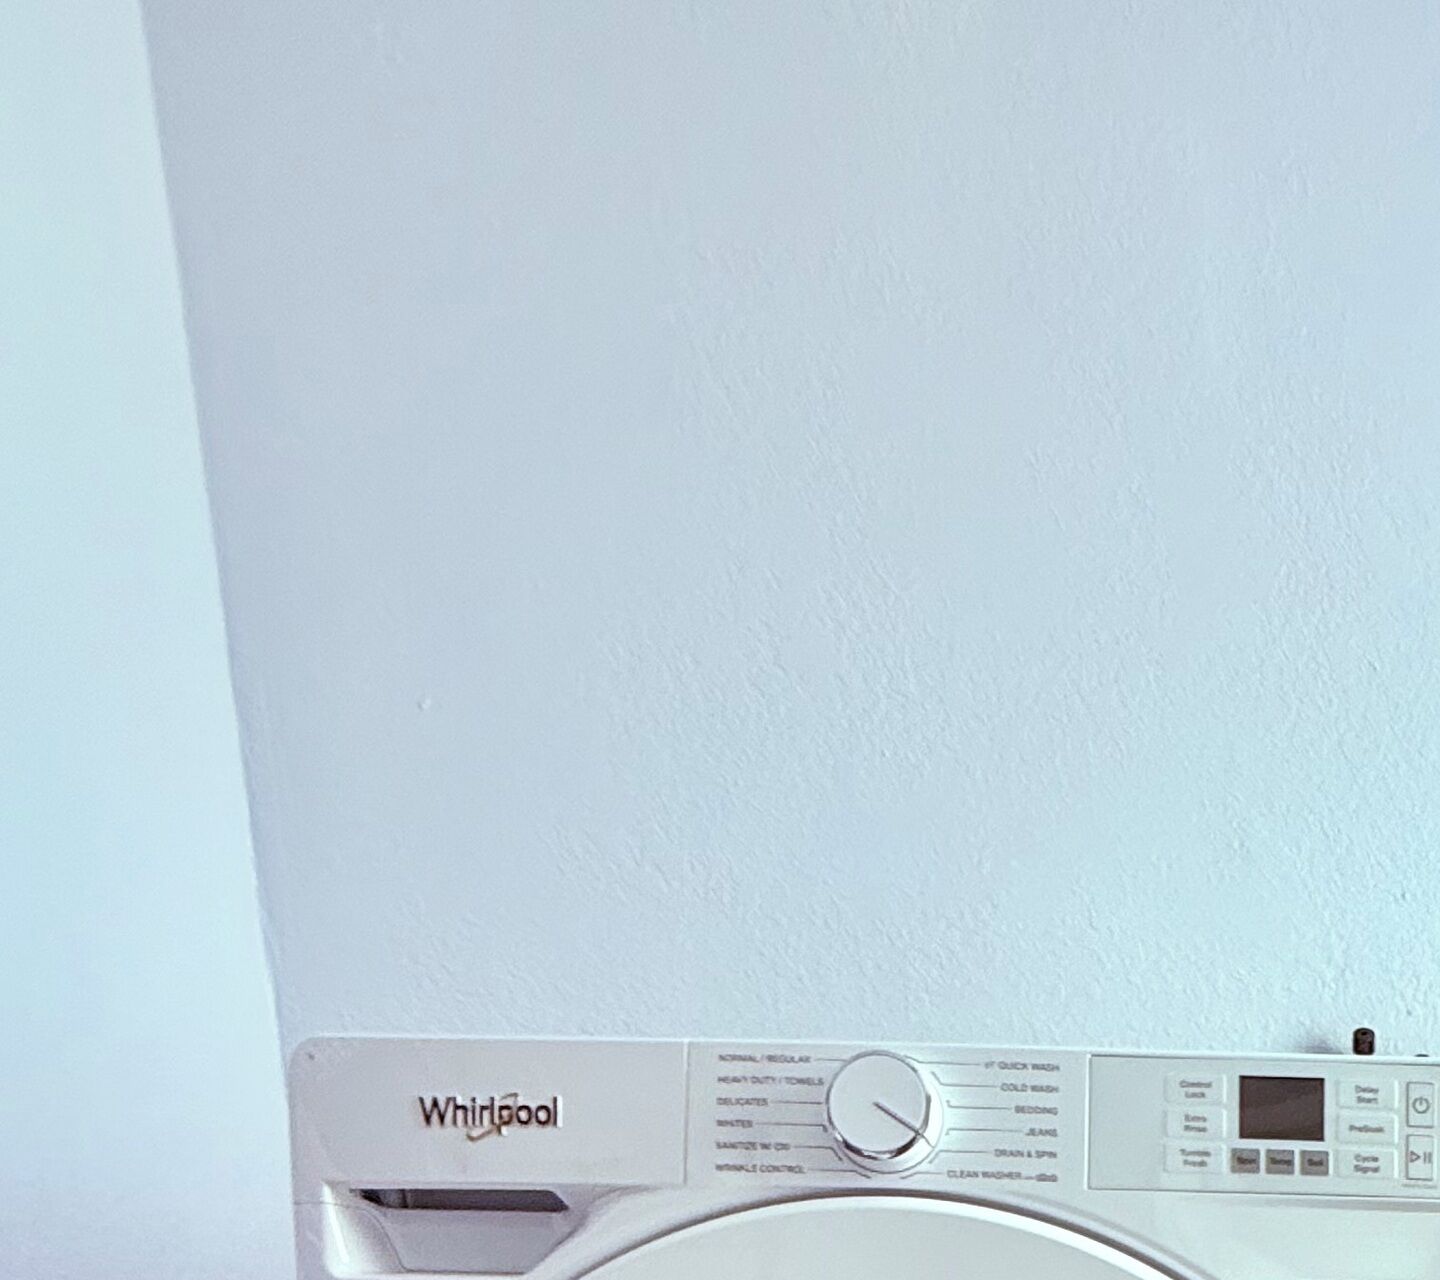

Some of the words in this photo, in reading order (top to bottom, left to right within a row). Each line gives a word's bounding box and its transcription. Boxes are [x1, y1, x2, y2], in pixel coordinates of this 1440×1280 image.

[998, 1061, 1029, 1071] QUICK
[1031, 1063, 1060, 1072] WASH
[1000, 1082, 1028, 1092] COLD
[1030, 1084, 1060, 1093] WASH
[418, 1093, 559, 1138] Whirlpool
[1014, 1105, 1059, 1116] BEDDING
